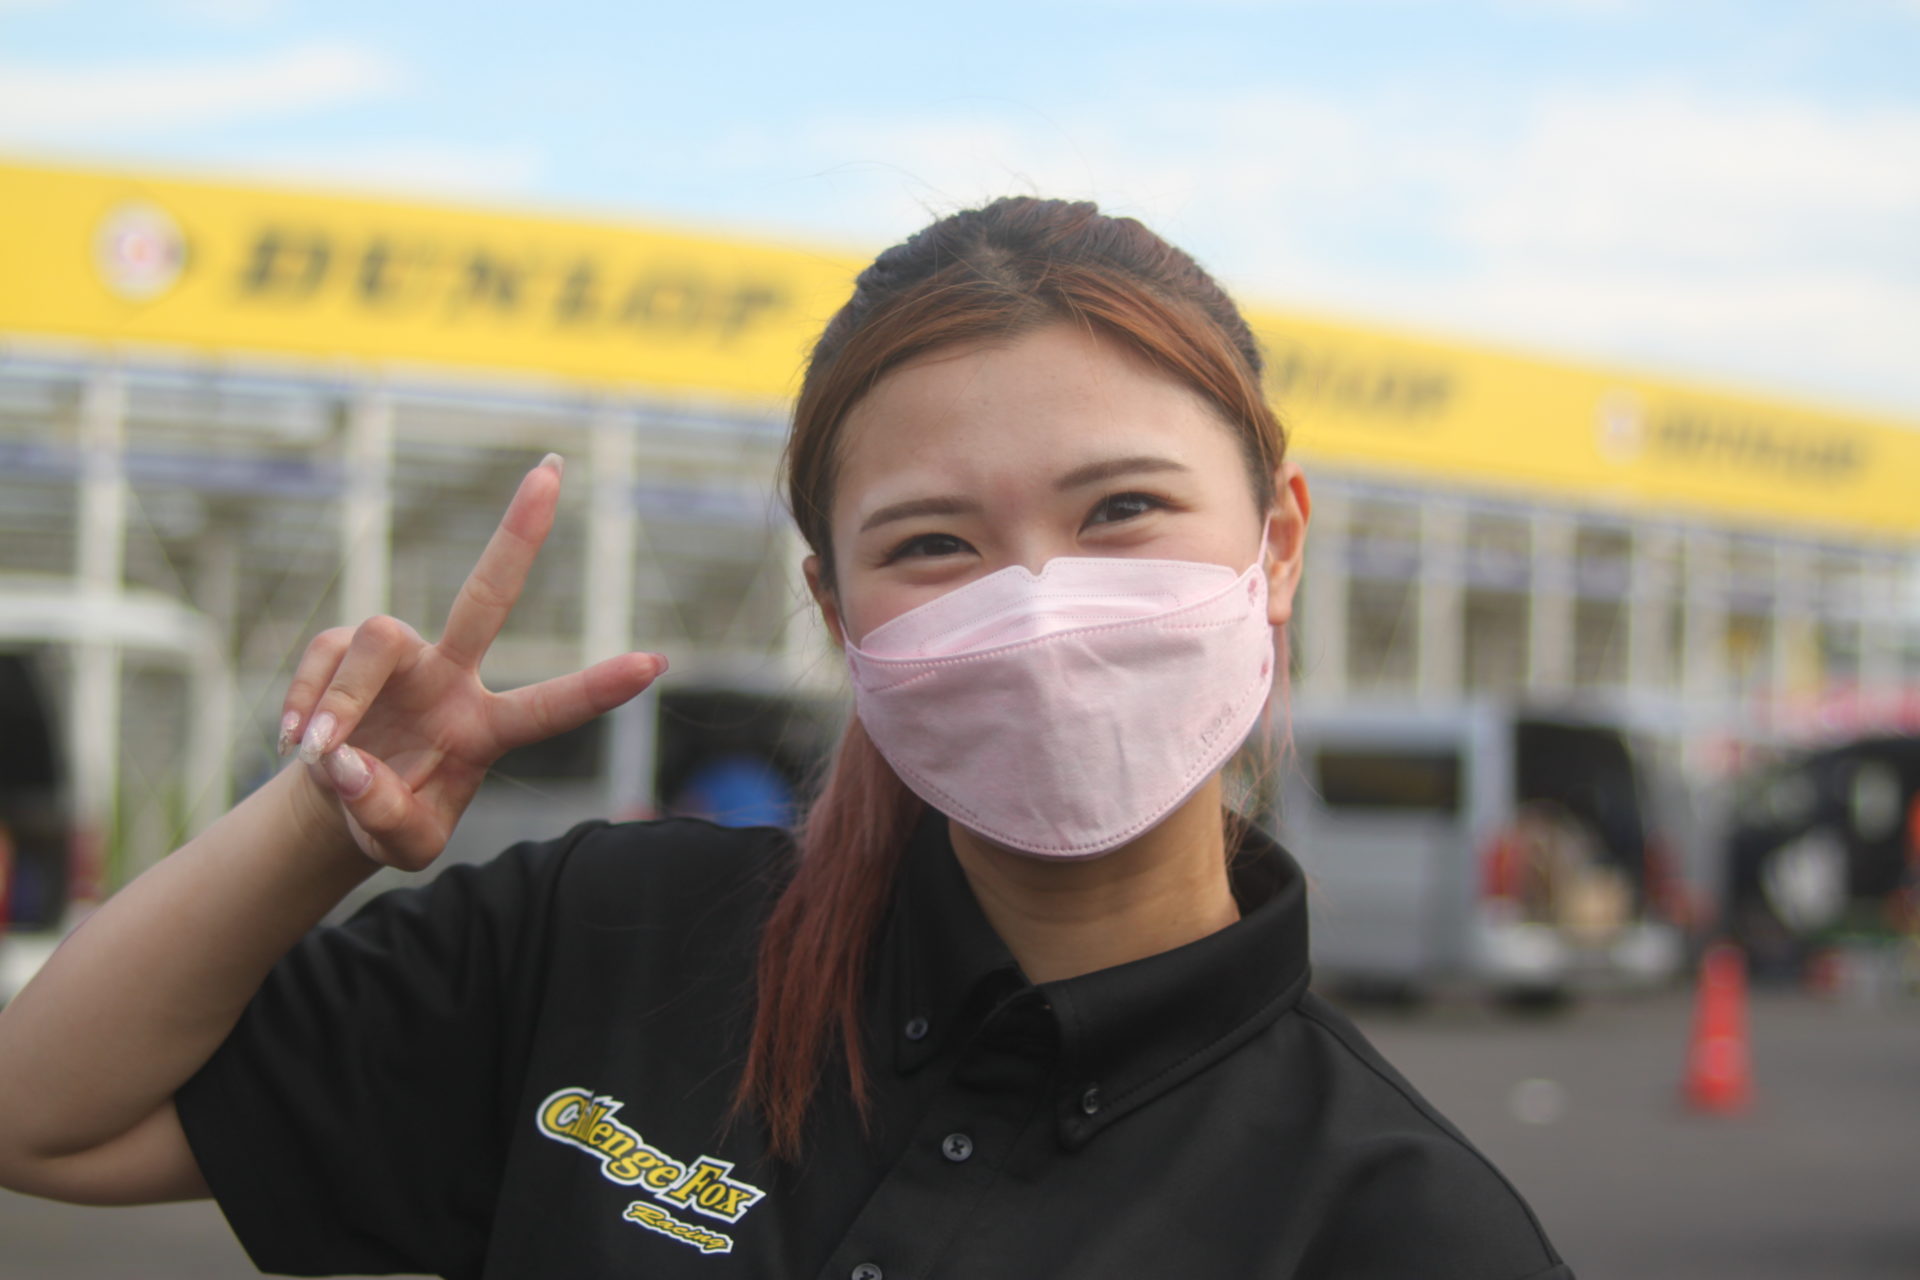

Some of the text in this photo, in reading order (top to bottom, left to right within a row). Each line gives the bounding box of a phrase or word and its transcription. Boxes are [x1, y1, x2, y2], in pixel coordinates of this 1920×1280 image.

[236, 222, 788, 338] DUNLOP
[664, 1159, 758, 1218] Fox
[626, 1202, 730, 1251] Racing
